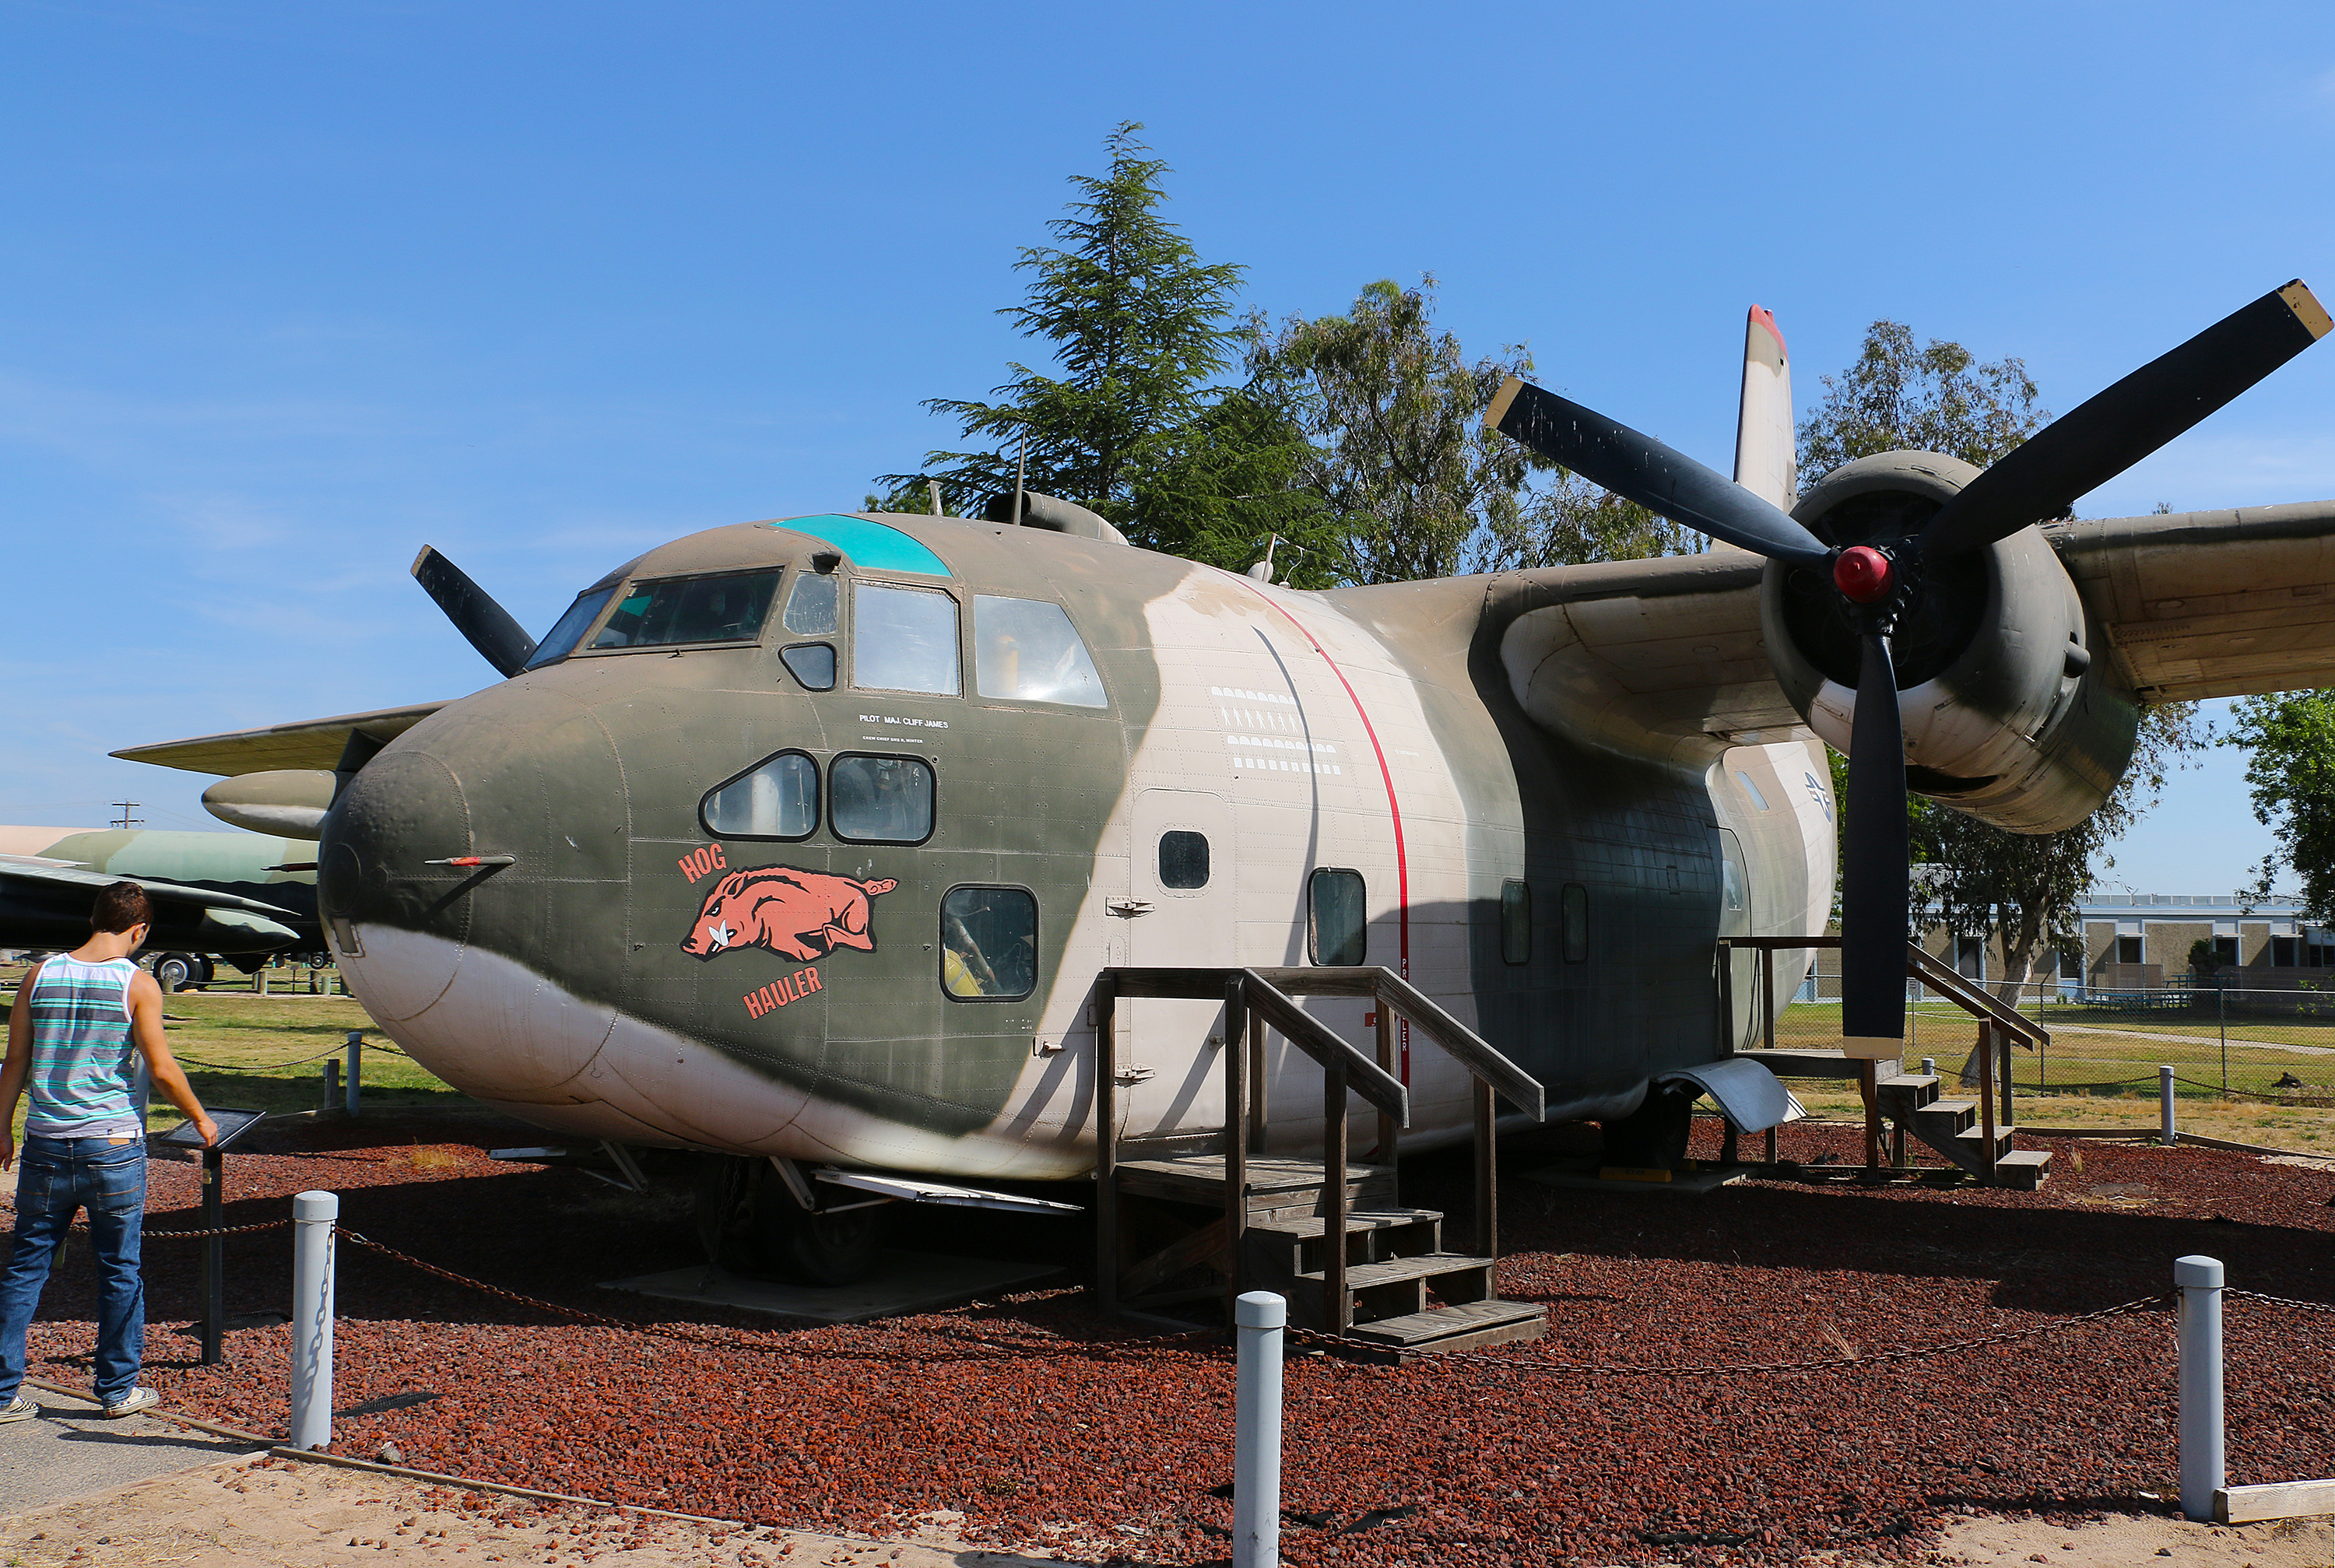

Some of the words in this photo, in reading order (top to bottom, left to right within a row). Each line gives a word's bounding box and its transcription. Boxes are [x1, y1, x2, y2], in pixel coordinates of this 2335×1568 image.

[859, 714, 880, 723] PILOT
[884, 716, 902, 724] MAJ.
[903, 717, 924, 727] CLIFF
[924, 720, 949, 729] JAMES
[678, 843, 728, 884] HOG
[743, 966, 823, 1020] HAULER
